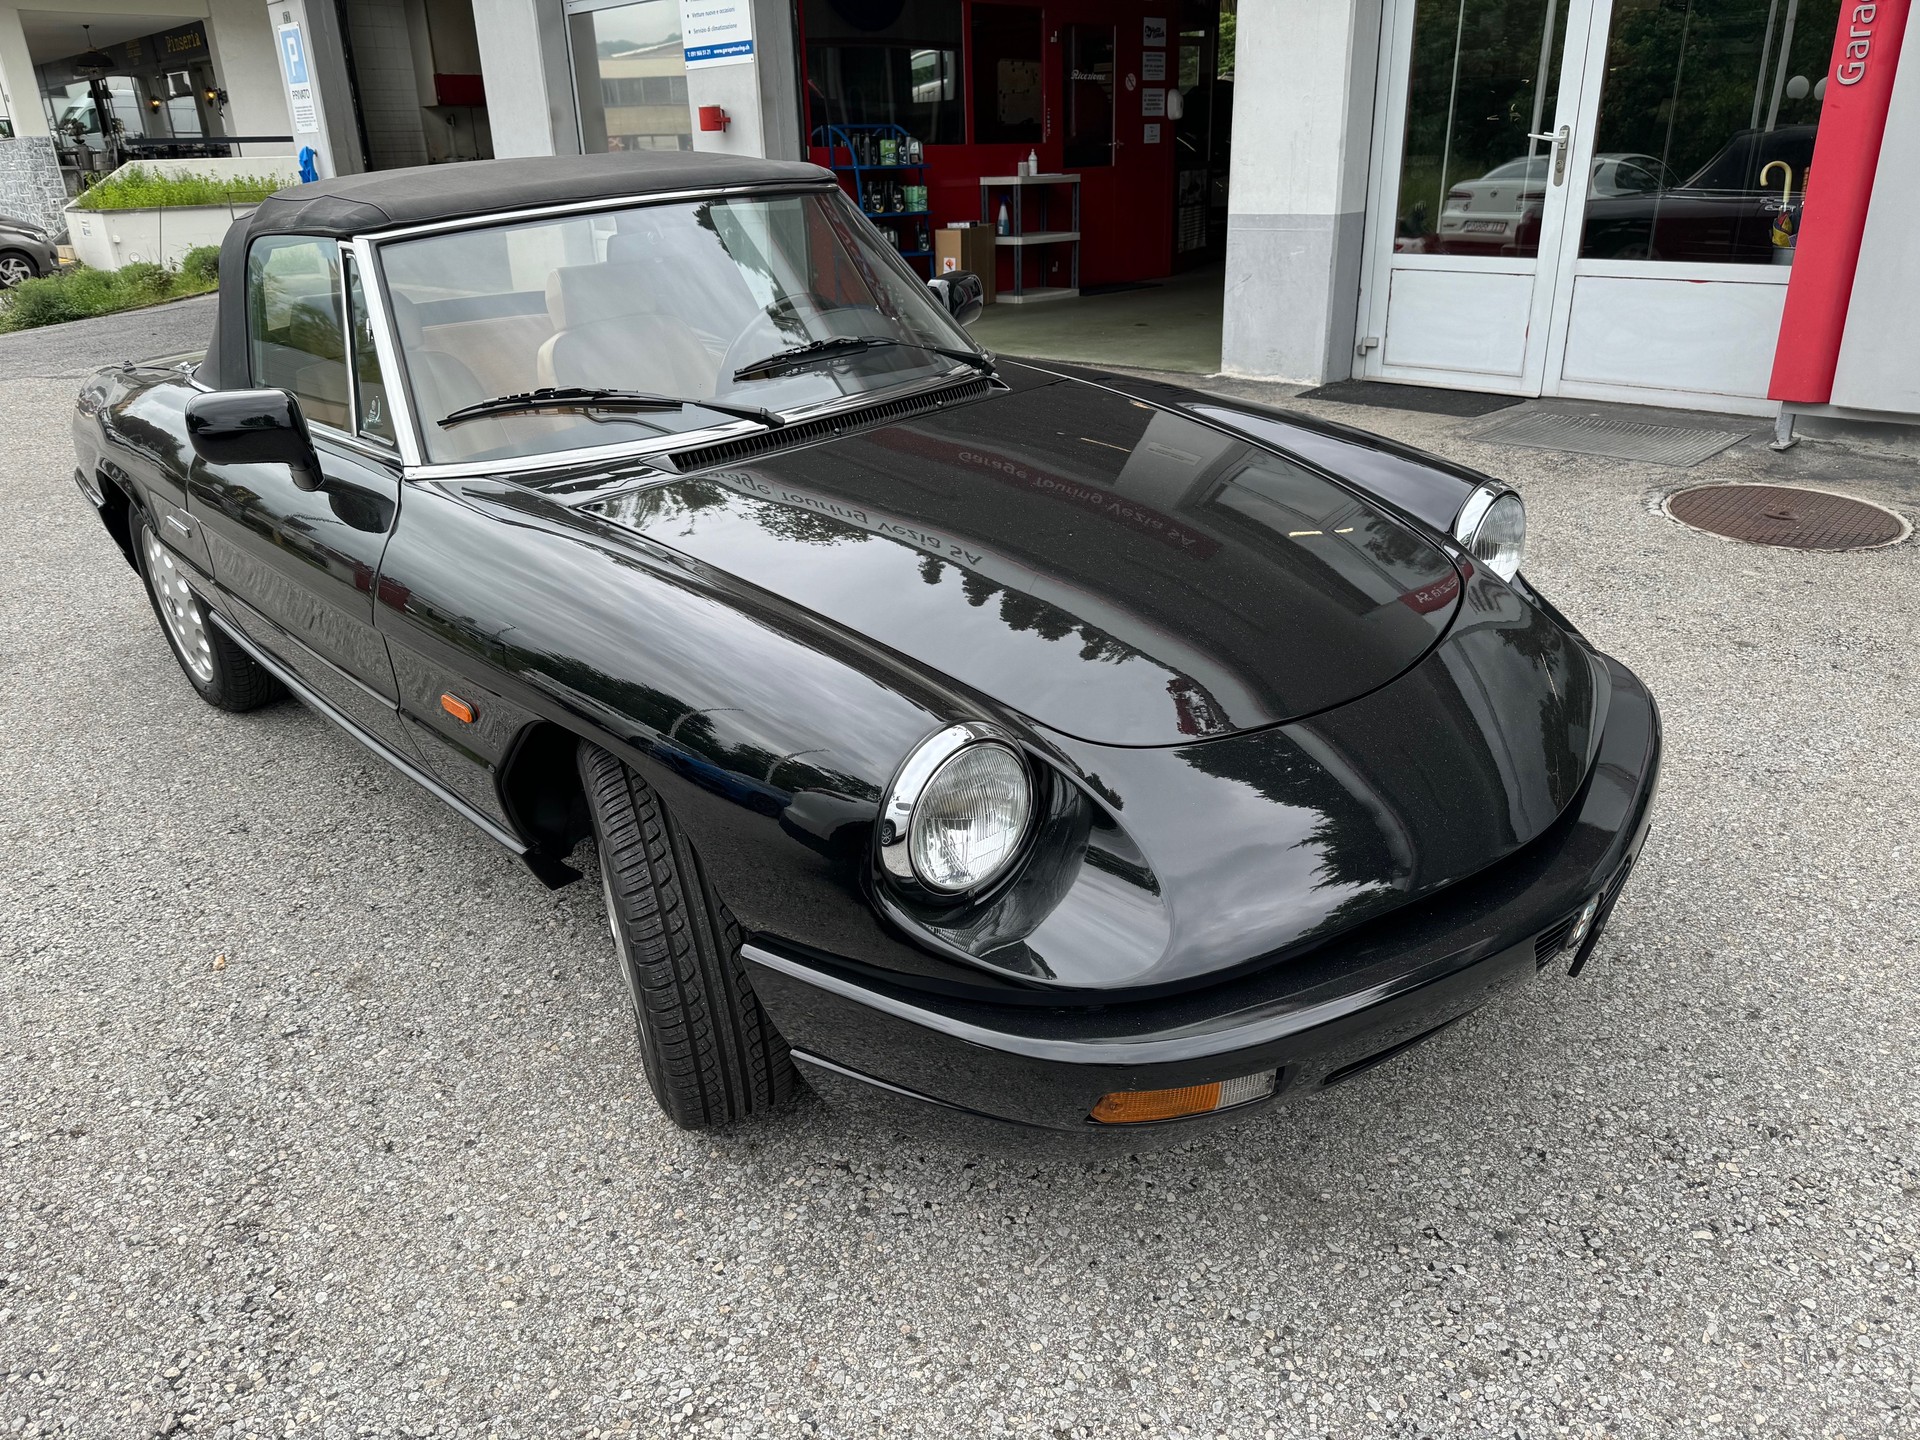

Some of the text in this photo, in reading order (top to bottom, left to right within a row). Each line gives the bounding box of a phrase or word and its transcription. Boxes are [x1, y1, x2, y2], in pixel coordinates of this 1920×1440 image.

[165, 31, 202, 53] Pinseria
[1837, 0, 1877, 85] Gara
[286, 37, 299, 76] P
[1070, 69, 1106, 80] Ricezione
[292, 89, 311, 101] PRIVATO
